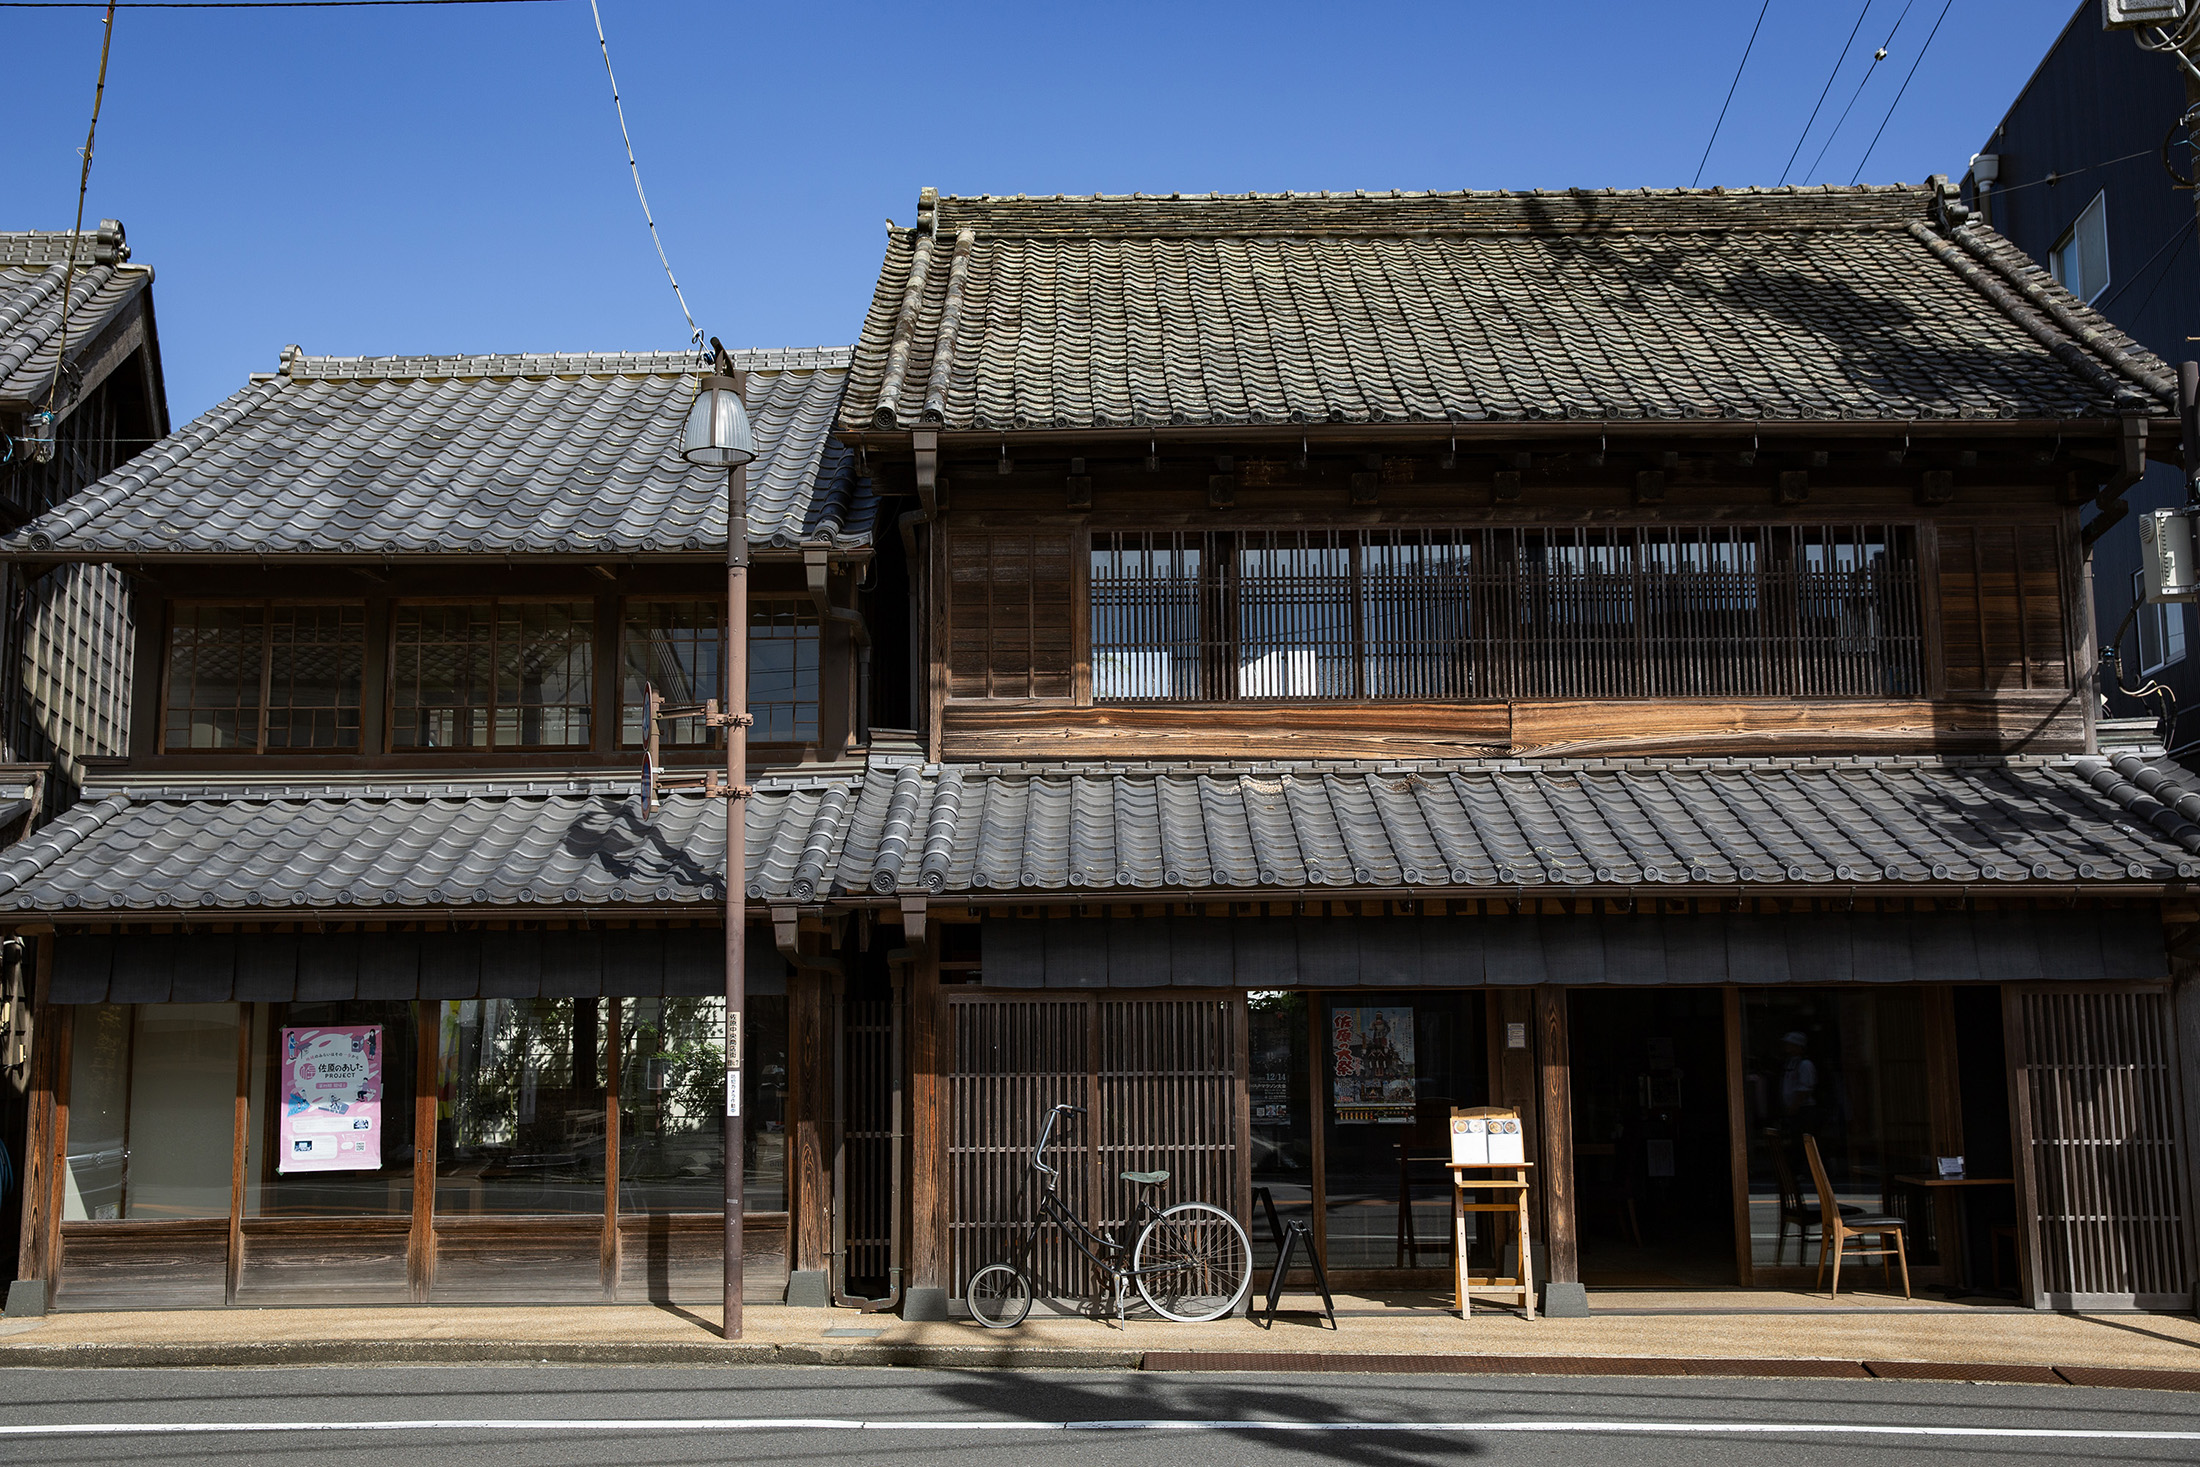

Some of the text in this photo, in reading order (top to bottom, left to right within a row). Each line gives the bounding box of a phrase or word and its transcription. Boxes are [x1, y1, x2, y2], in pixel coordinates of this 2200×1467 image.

[1334, 1015, 1354, 1076] 佐原の大祭
[318, 1063, 364, 1073] 佐原のあした
[1266, 1073, 1286, 1081] 12/14
